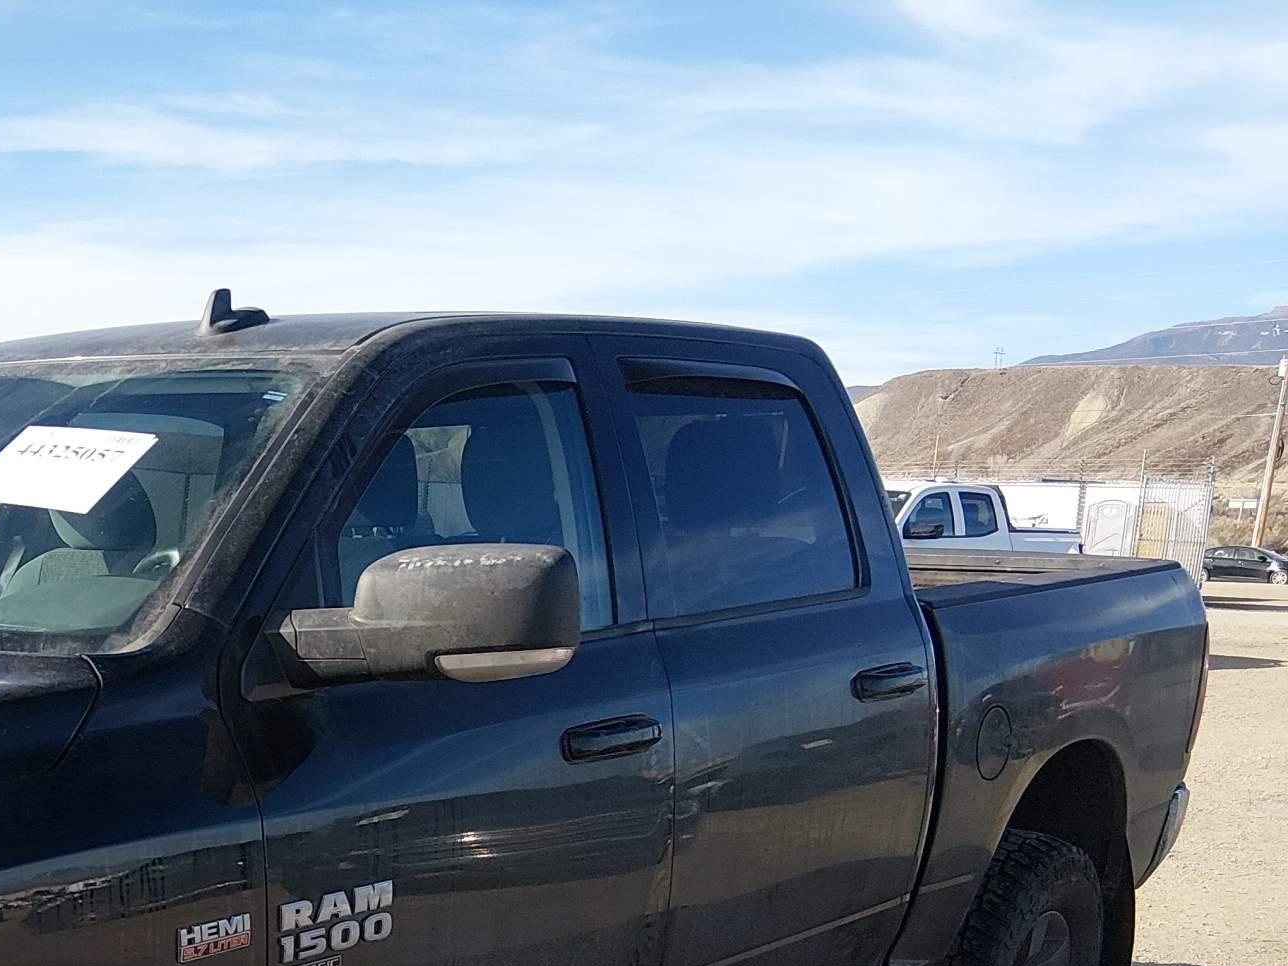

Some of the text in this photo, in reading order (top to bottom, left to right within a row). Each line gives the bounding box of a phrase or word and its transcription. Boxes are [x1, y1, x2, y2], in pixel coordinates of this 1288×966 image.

[179, 913, 251, 947] HEMI
[279, 879, 394, 933] RAM
[279, 911, 394, 964] 1500
